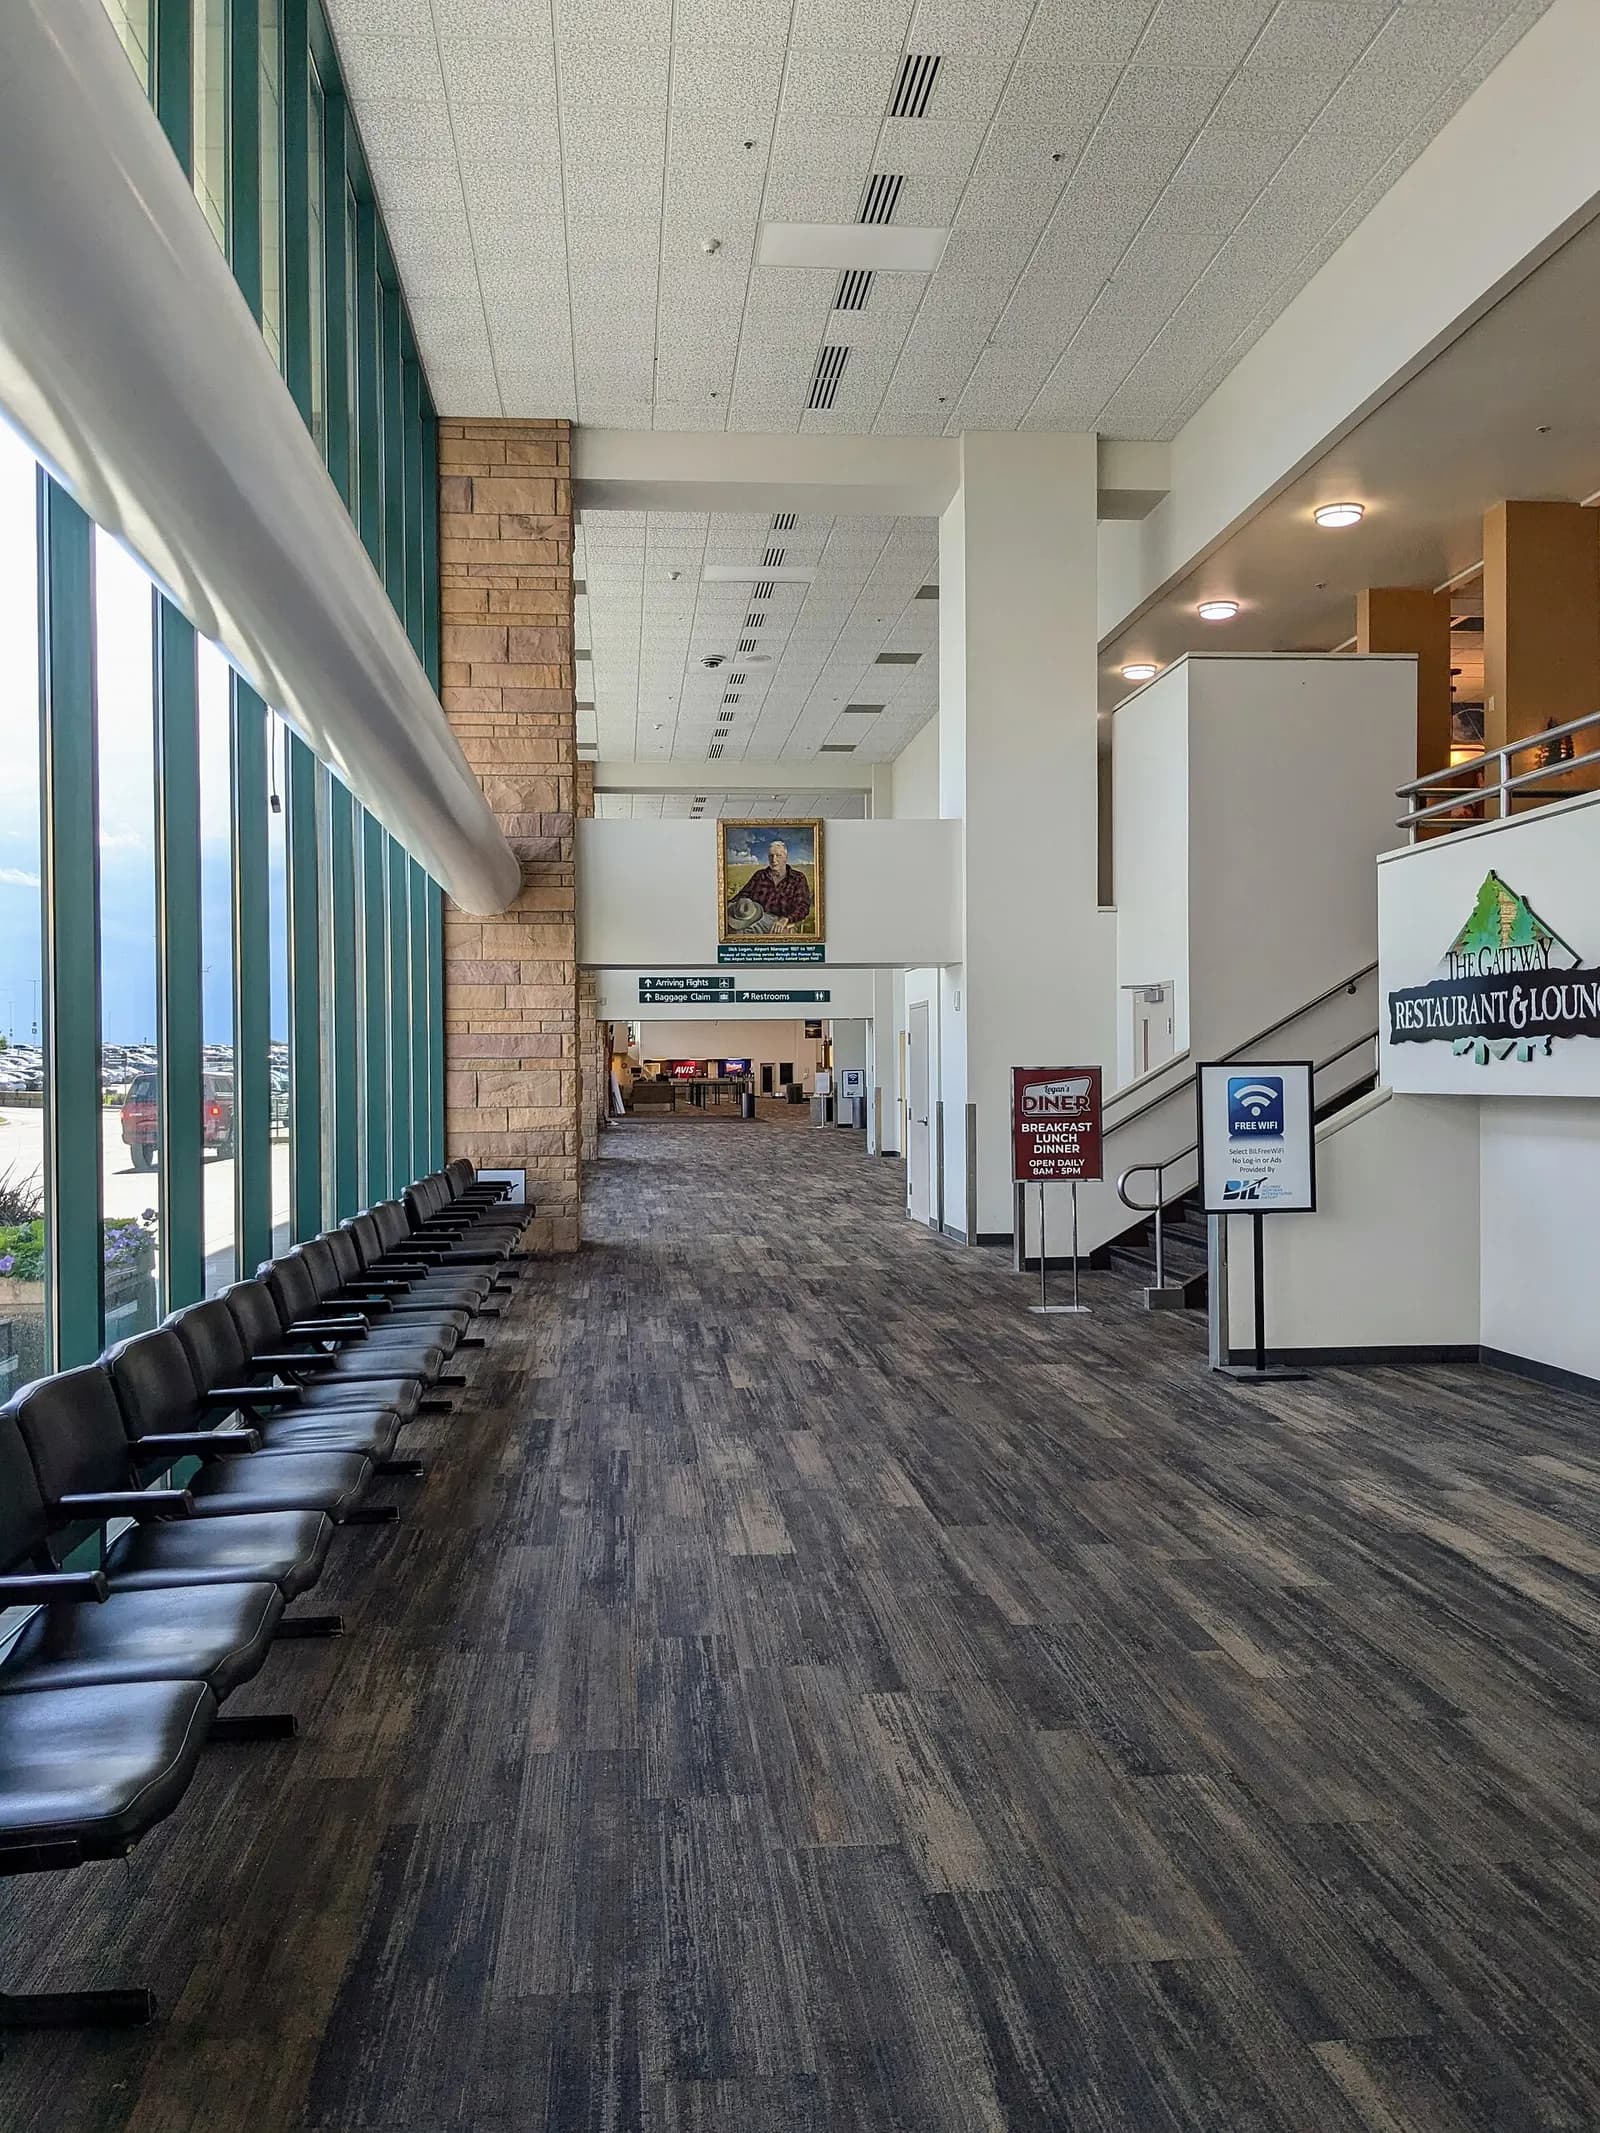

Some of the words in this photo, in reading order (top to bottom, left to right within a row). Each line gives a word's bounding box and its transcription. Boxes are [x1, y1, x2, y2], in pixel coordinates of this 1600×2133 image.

[1446, 951, 1475, 981] THE
[1478, 937, 1553, 977] GATEWAY
[655, 978, 684, 988] Arriving
[686, 978, 709, 988] Flights
[655, 992, 688, 1003] Baggage
[690, 992, 711, 1001] Claim
[751, 992, 790, 1001] Restrooms
[1395, 990, 1508, 1030] RESTAURANT
[1509, 984, 1529, 1029] &
[1529, 982, 1600, 1022] LOUN
[675, 1066, 695, 1074] AVIS
[1045, 1085, 1070, 1095] Logan's
[1022, 1095, 1091, 1112] DINER
[1021, 1122, 1092, 1133] BREAKFAST
[1234, 1121, 1257, 1130] FREE
[1257, 1121, 1278, 1130] WIFI
[1036, 1133, 1077, 1143] LUNCH
[1033, 1144, 1080, 1154] DINNER
[1029, 1159, 1055, 1167] OPEN
[1057, 1159, 1085, 1167] DAILY
[1033, 1167, 1053, 1175] 8AM
[1061, 1167, 1081, 1175] 5PM
